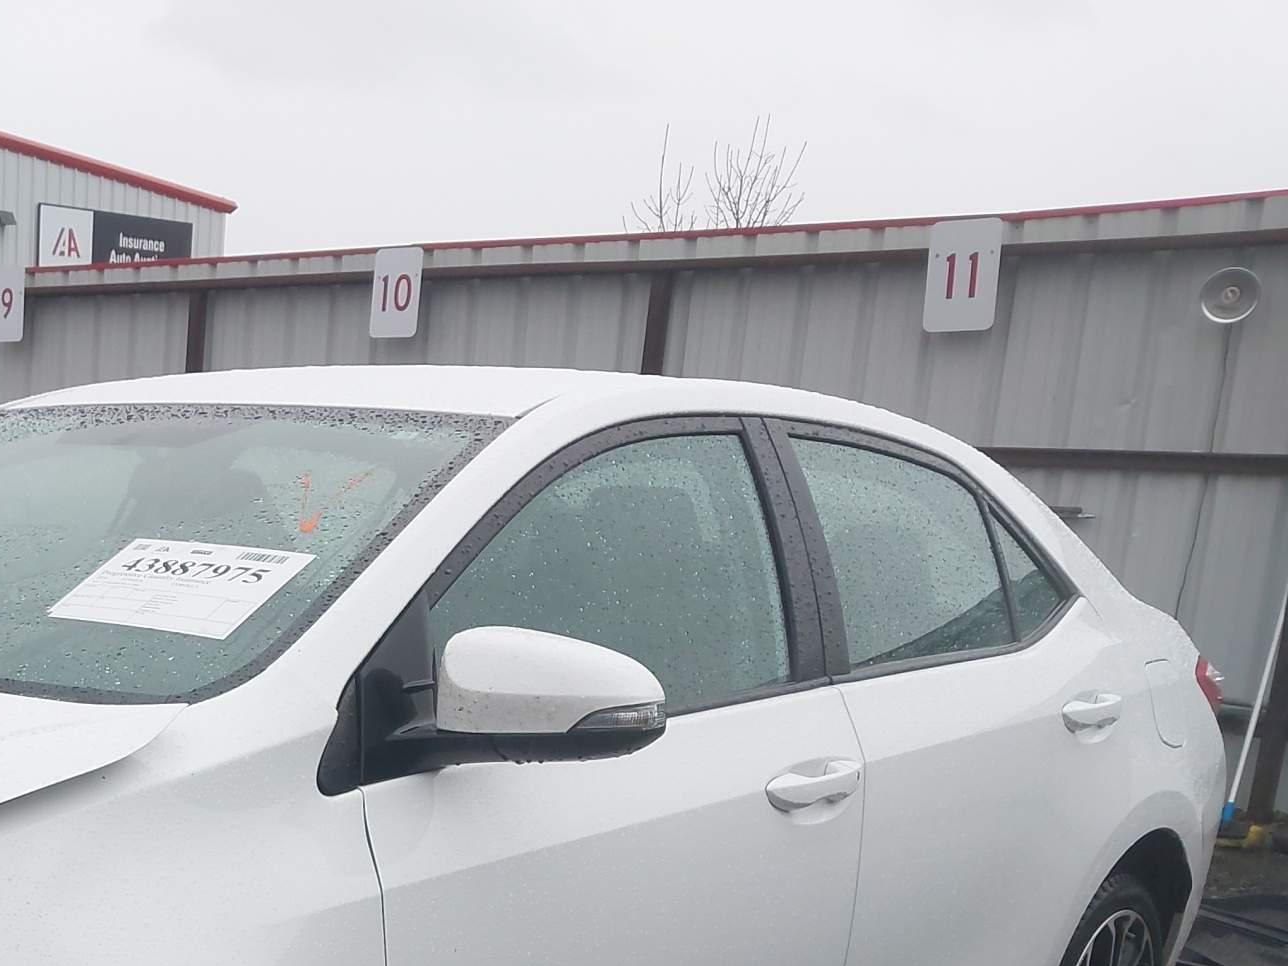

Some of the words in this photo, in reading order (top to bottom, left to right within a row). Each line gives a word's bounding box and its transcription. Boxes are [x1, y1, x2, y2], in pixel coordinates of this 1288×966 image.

[119, 231, 165, 252] Insurance
[109, 249, 132, 264] Auto
[945, 251, 980, 300] 11
[1, 287, 13, 319] 9
[381, 273, 412, 312] 10
[121, 557, 272, 584] 43887975
